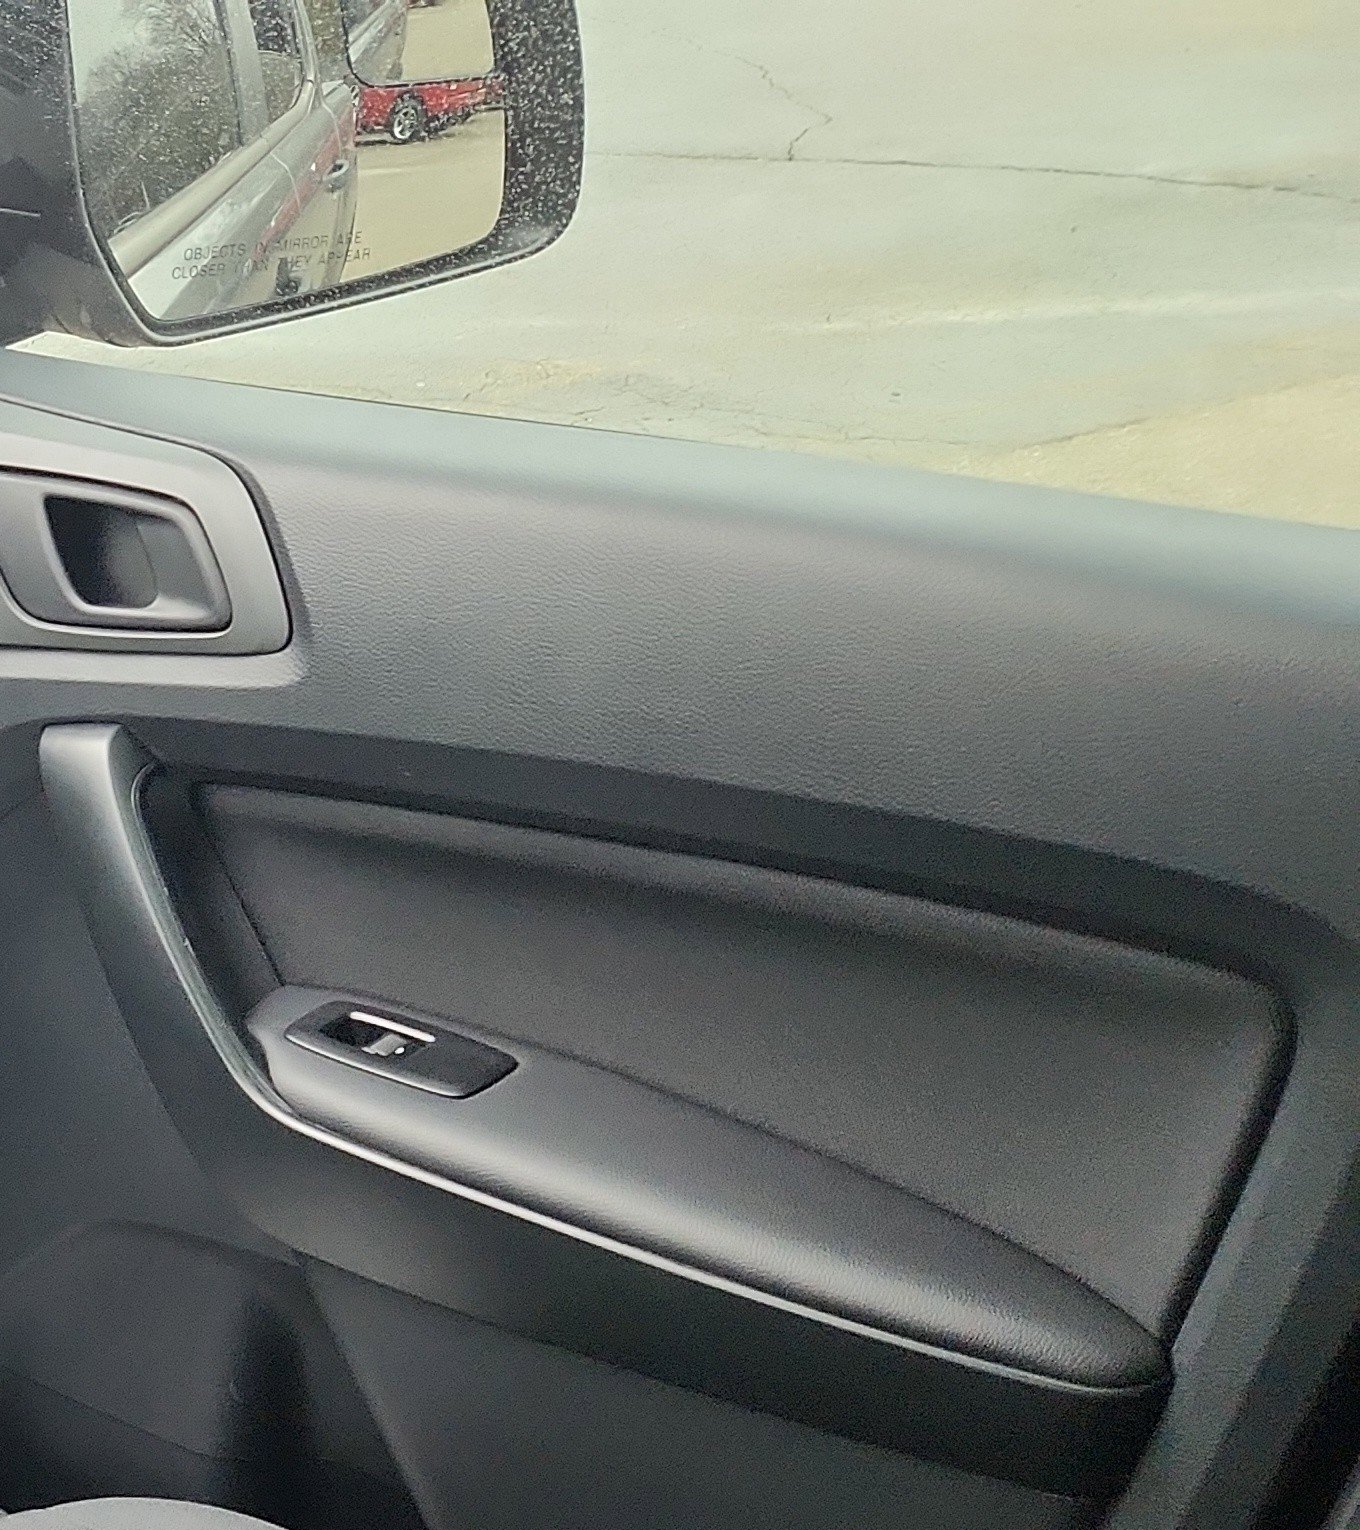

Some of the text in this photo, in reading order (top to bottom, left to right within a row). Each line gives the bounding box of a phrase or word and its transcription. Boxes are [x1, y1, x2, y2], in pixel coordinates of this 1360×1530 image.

[183, 243, 247, 261] OBJECTS
[276, 235, 329, 252] MIRROR
[336, 231, 363, 246] ARE
[171, 263, 226, 280] CLOSER
